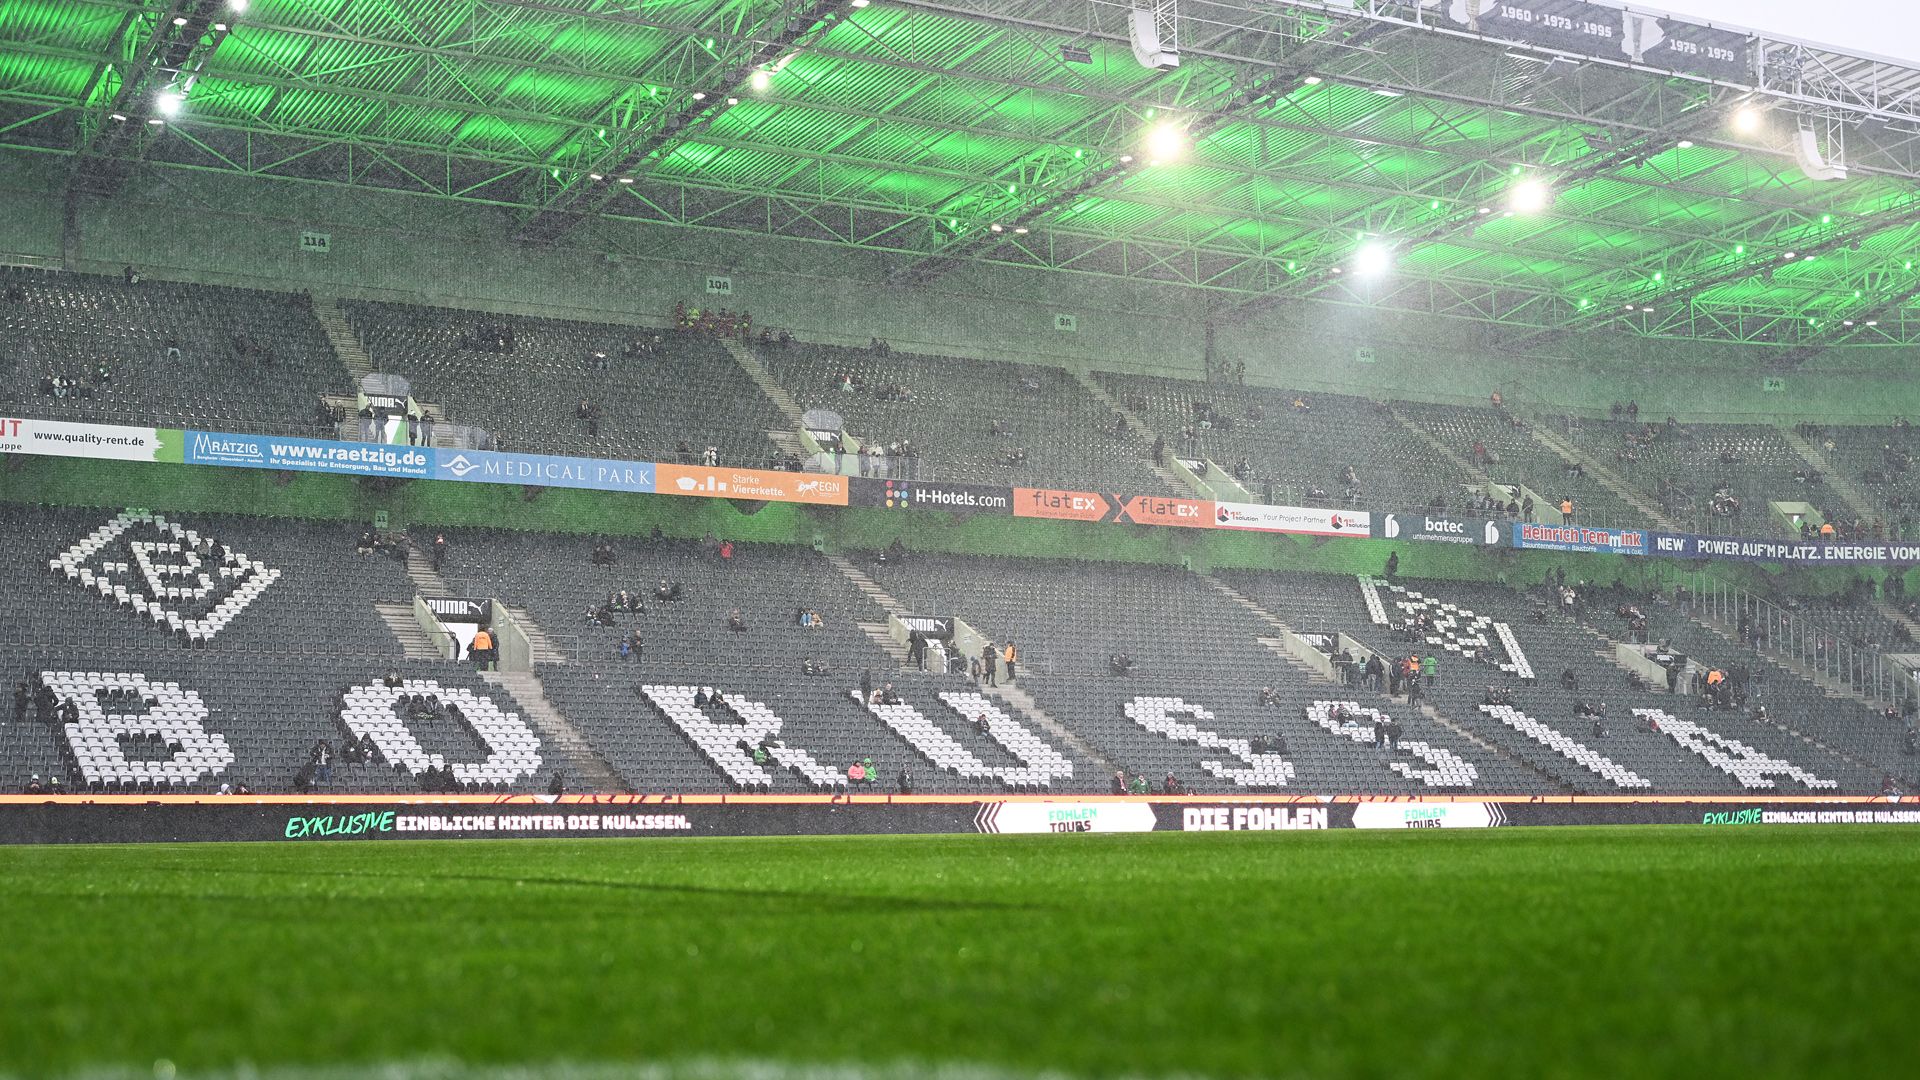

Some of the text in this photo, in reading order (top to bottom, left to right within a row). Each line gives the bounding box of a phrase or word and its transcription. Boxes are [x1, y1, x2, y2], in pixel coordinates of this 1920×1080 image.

[1501, 5, 1612, 38] 1960 1973 1995
[1670, 38, 1735, 62] 1975 1979
[304, 236, 326, 247] 11A
[709, 280, 729, 289] 10A
[34, 431, 144, 446] www.quality-rent.de
[271, 444, 426, 466] www.raetzig.de
[282, 458, 316, 467] Spezialist
[484, 459, 651, 485] MEDICAL PARK
[732, 474, 760, 484] Starke
[732, 484, 786, 497] Viererkette.
[820, 482, 840, 493] EGN
[916, 489, 1006, 507] H-Hotels.com
[1263, 513, 1326, 524] Your Project Partner
[1425, 517, 1464, 533] batec
[1413, 533, 1474, 544] unternehmensgruppe
[1522, 524, 1642, 547] Heinrich Temmink
[1657, 538, 1684, 551] NEW
[1698, 540, 1739, 555] POWER
[1778, 545, 1821, 559] PLATZ.
[1825, 547, 1887, 560] ENERGIE
[1889, 546, 1920, 560] VOM
[1048, 808, 1097, 821] FOHLEN
[1183, 807, 1328, 831] DIE FOHLEN
[1405, 808, 1446, 820] FOHLEN
[1703, 808, 1762, 825] EXKLUSIVE
[285, 811, 691, 838] EXKLUSIVE EINBLICKE HINTER DIE KULISSEN.
